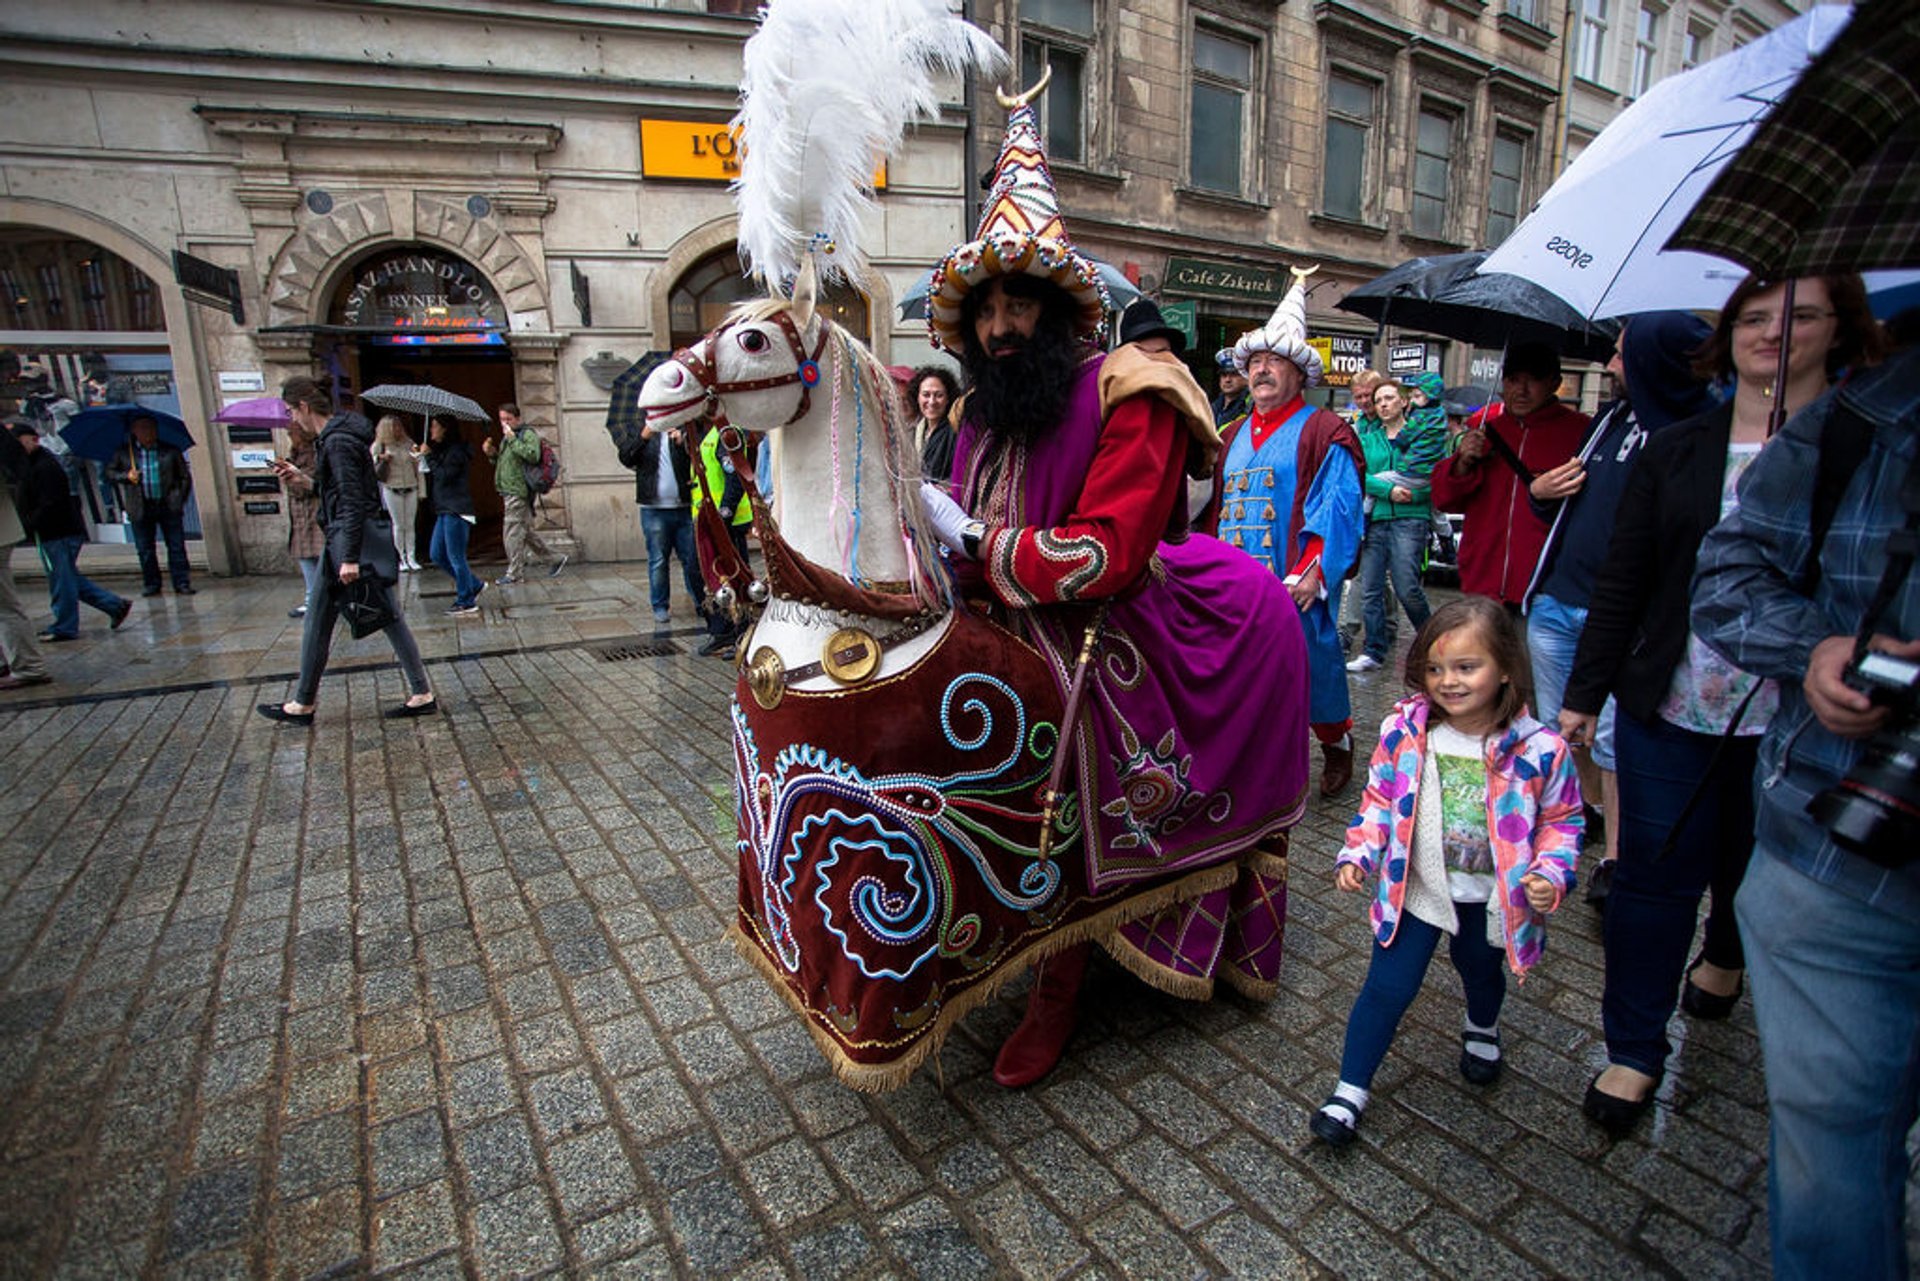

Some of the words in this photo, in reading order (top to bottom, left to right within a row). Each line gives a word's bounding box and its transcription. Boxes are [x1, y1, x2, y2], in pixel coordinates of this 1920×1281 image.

[692, 131, 739, 158] L'O
[1178, 267, 1215, 286] Café
[389, 294, 449, 308] RYNEK
[1333, 337, 1364, 353] HANGE
[1332, 355, 1367, 373] NTOR
